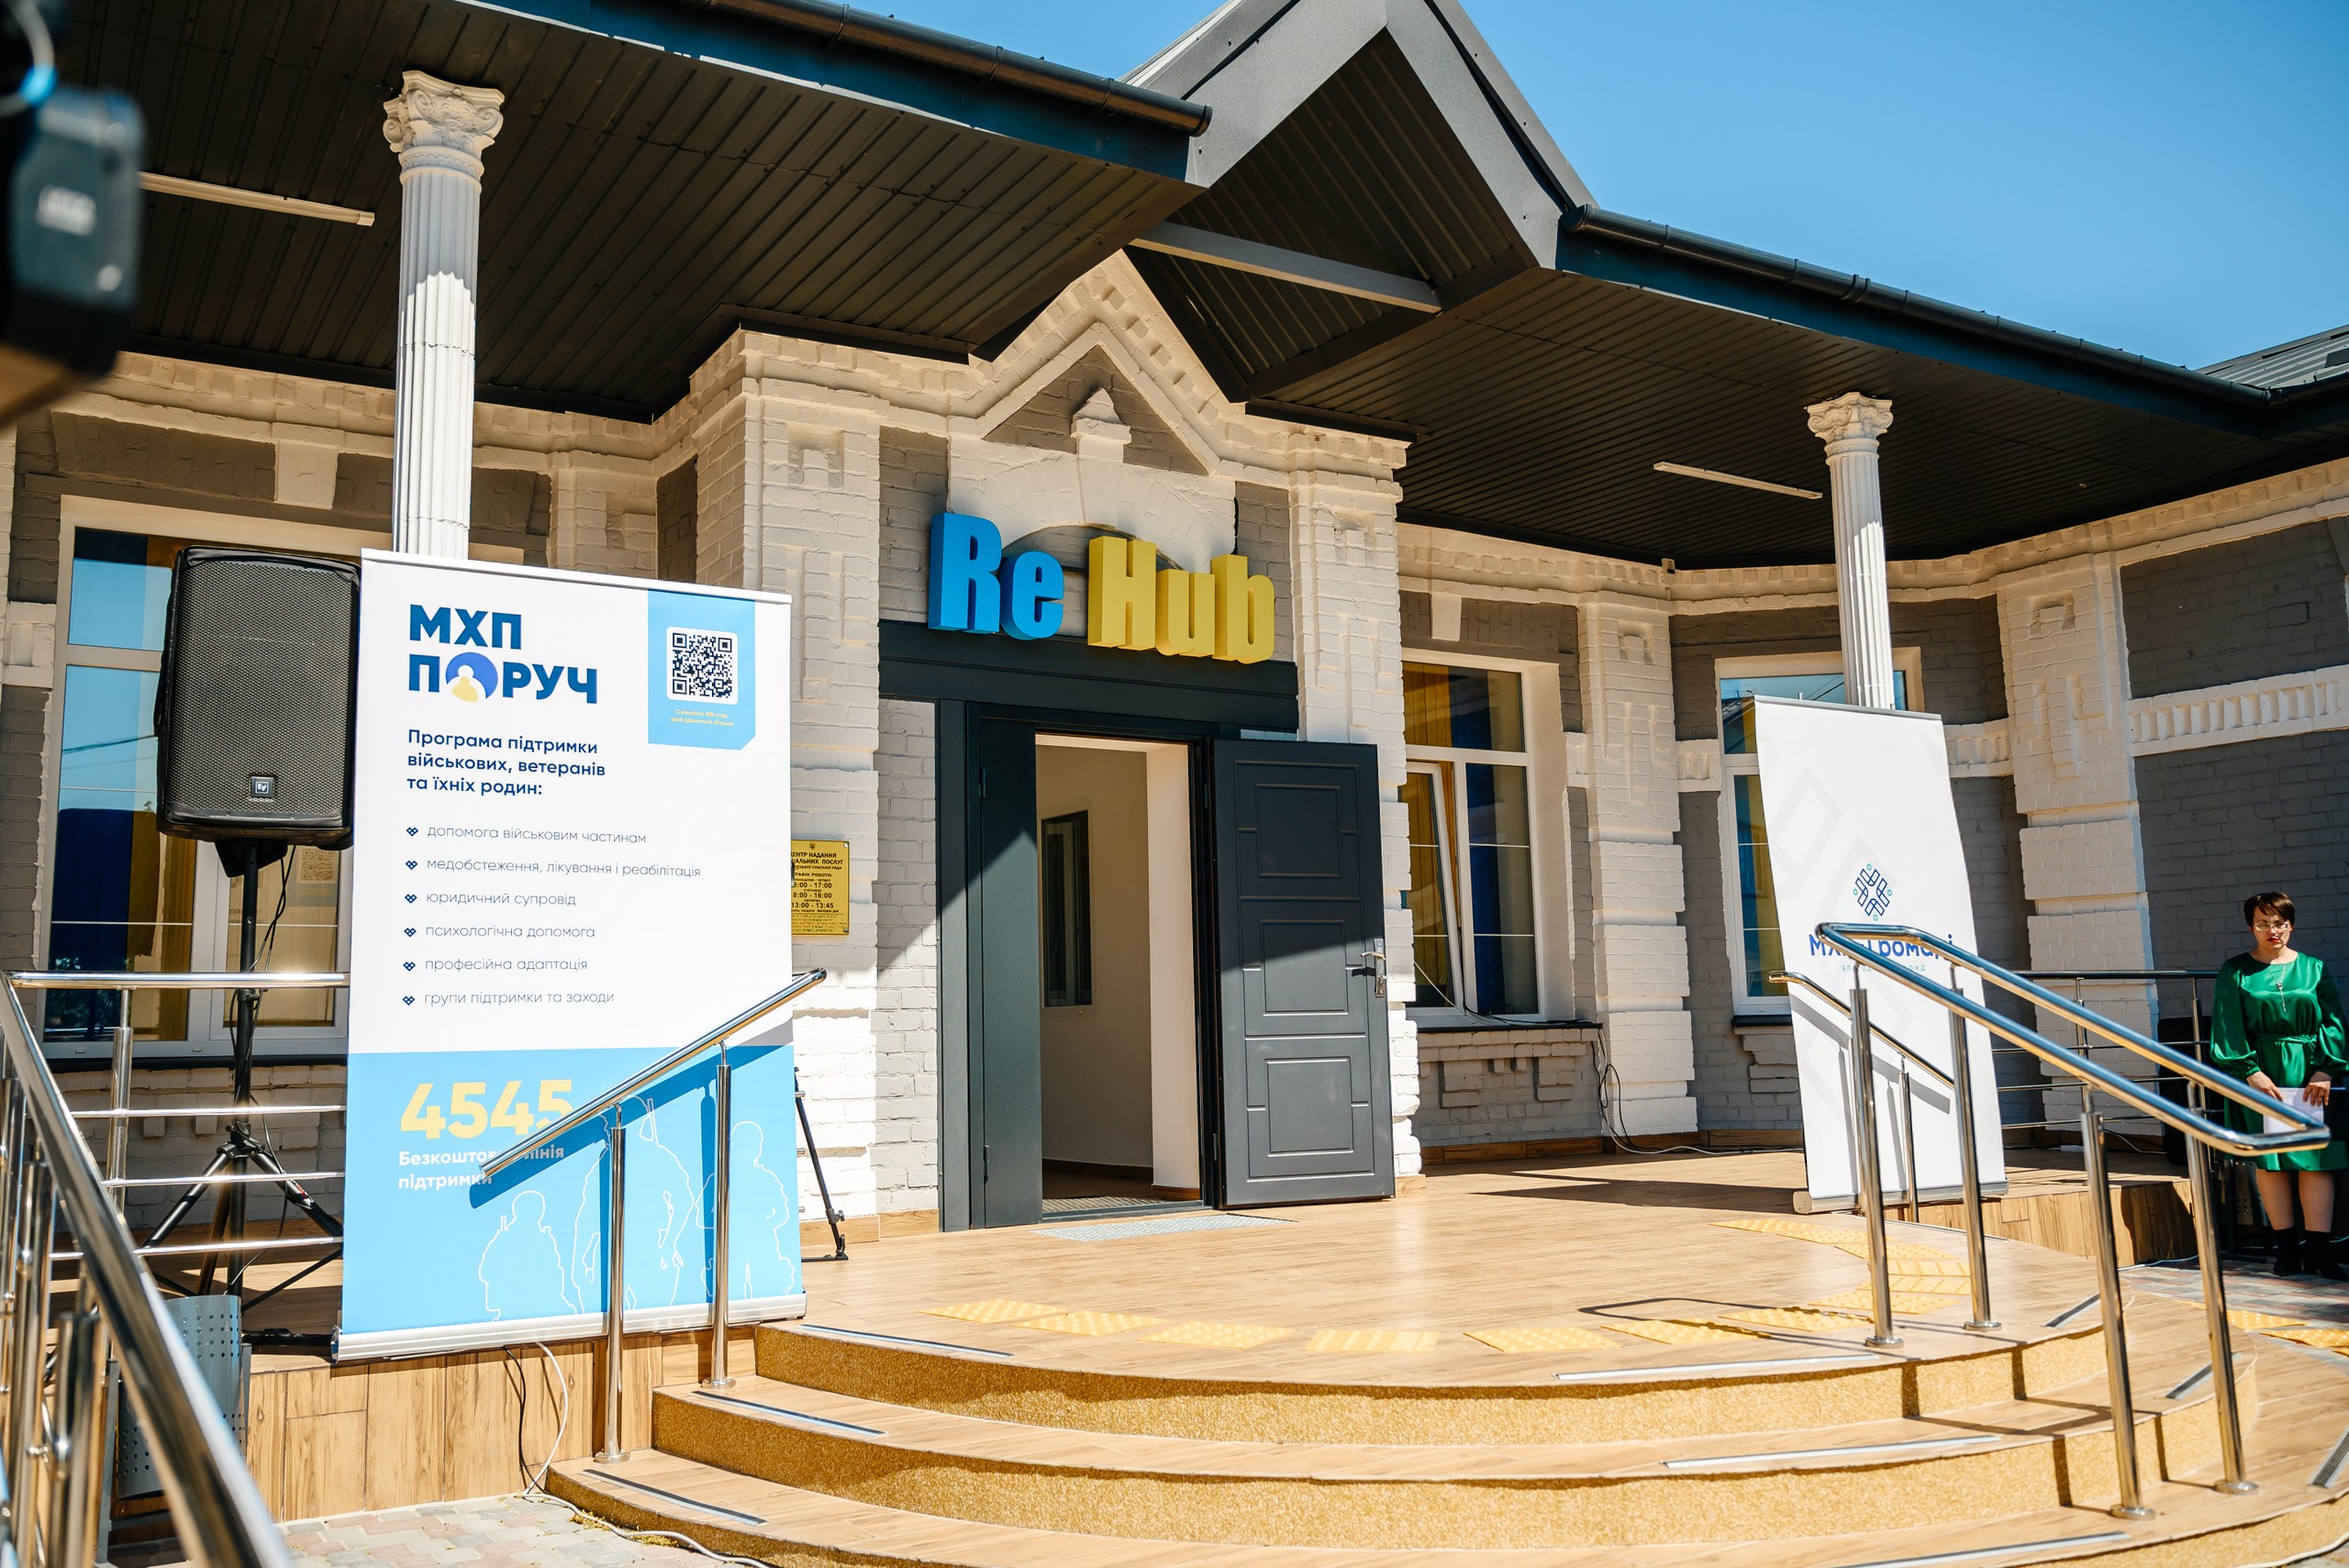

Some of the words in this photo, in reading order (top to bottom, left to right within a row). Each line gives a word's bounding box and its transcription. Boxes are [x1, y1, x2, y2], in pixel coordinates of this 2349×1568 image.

[928, 512, 1064, 640] Re
[1087, 536, 1275, 664] Hub
[409, 604, 522, 651] МХП
[408, 729, 502, 751] Програма
[507, 735, 598, 754] підтримки
[407, 752, 513, 775] військових,
[518, 760, 606, 777] ветеранів
[406, 777, 429, 791] та
[433, 777, 475, 794] їхніх
[480, 782, 542, 795] родин:
[427, 827, 499, 840] допомога
[503, 827, 579, 841] військовим
[582, 830, 647, 844] частинам
[427, 858, 542, 874] медобстеження,
[546, 862, 612, 875] лікування
[615, 862, 619, 874] і
[622, 864, 701, 878] реабілітація
[426, 892, 510, 906] юридичний
[514, 892, 576, 907] супровід
[425, 924, 523, 939] психологічна
[527, 926, 596, 940] допомога
[425, 957, 512, 973] професійна
[516, 957, 588, 972] адаптація
[424, 992, 466, 1006] групи
[471, 989, 542, 1006] підтримки
[546, 992, 562, 1004] та
[565, 991, 615, 1006] заходи
[400, 1079, 573, 1140] 4545
[398, 1149, 506, 1166] Безкоштов
[398, 1172, 493, 1191] підтримки
